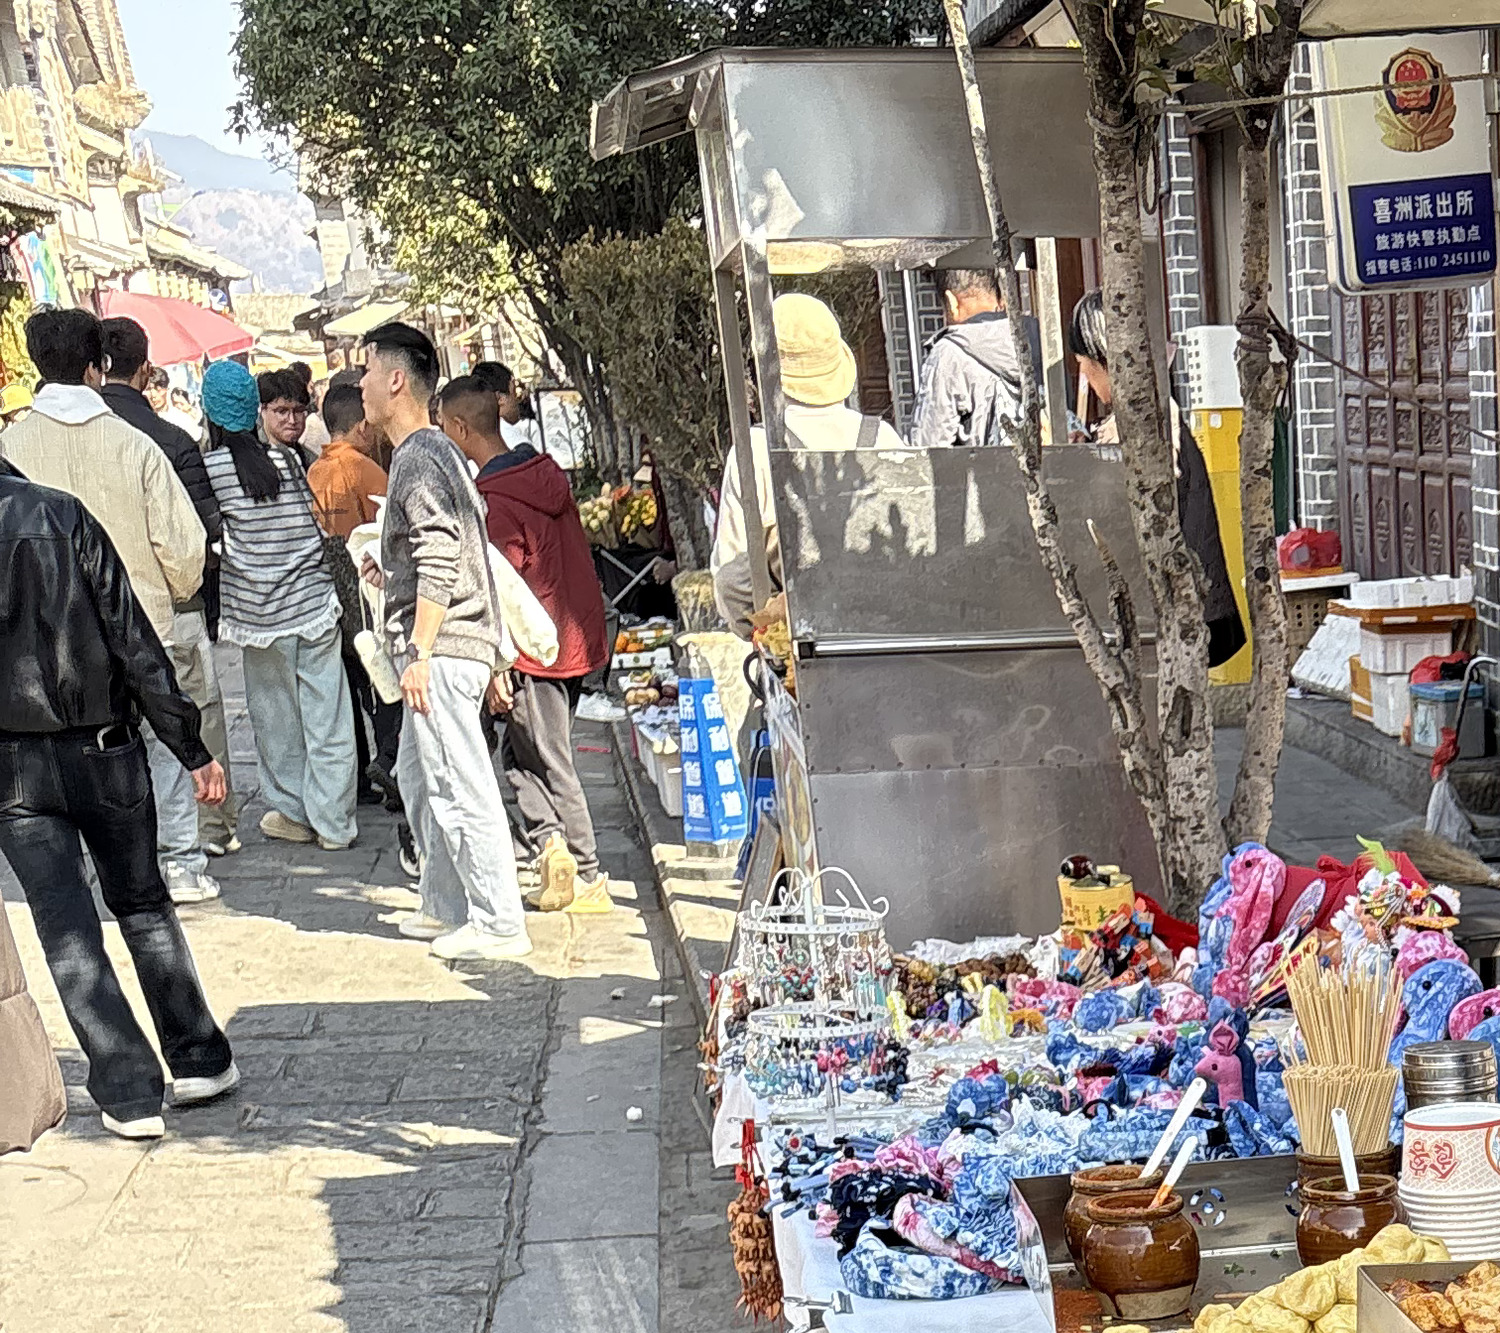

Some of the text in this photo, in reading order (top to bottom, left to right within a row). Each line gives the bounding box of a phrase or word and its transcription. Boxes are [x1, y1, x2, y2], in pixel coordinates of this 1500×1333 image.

[1373, 190, 1473, 224] 喜洲派出所
[1375, 225, 1482, 251] 旅游快警执勤点
[1442, 250, 1491, 268] 2451110
